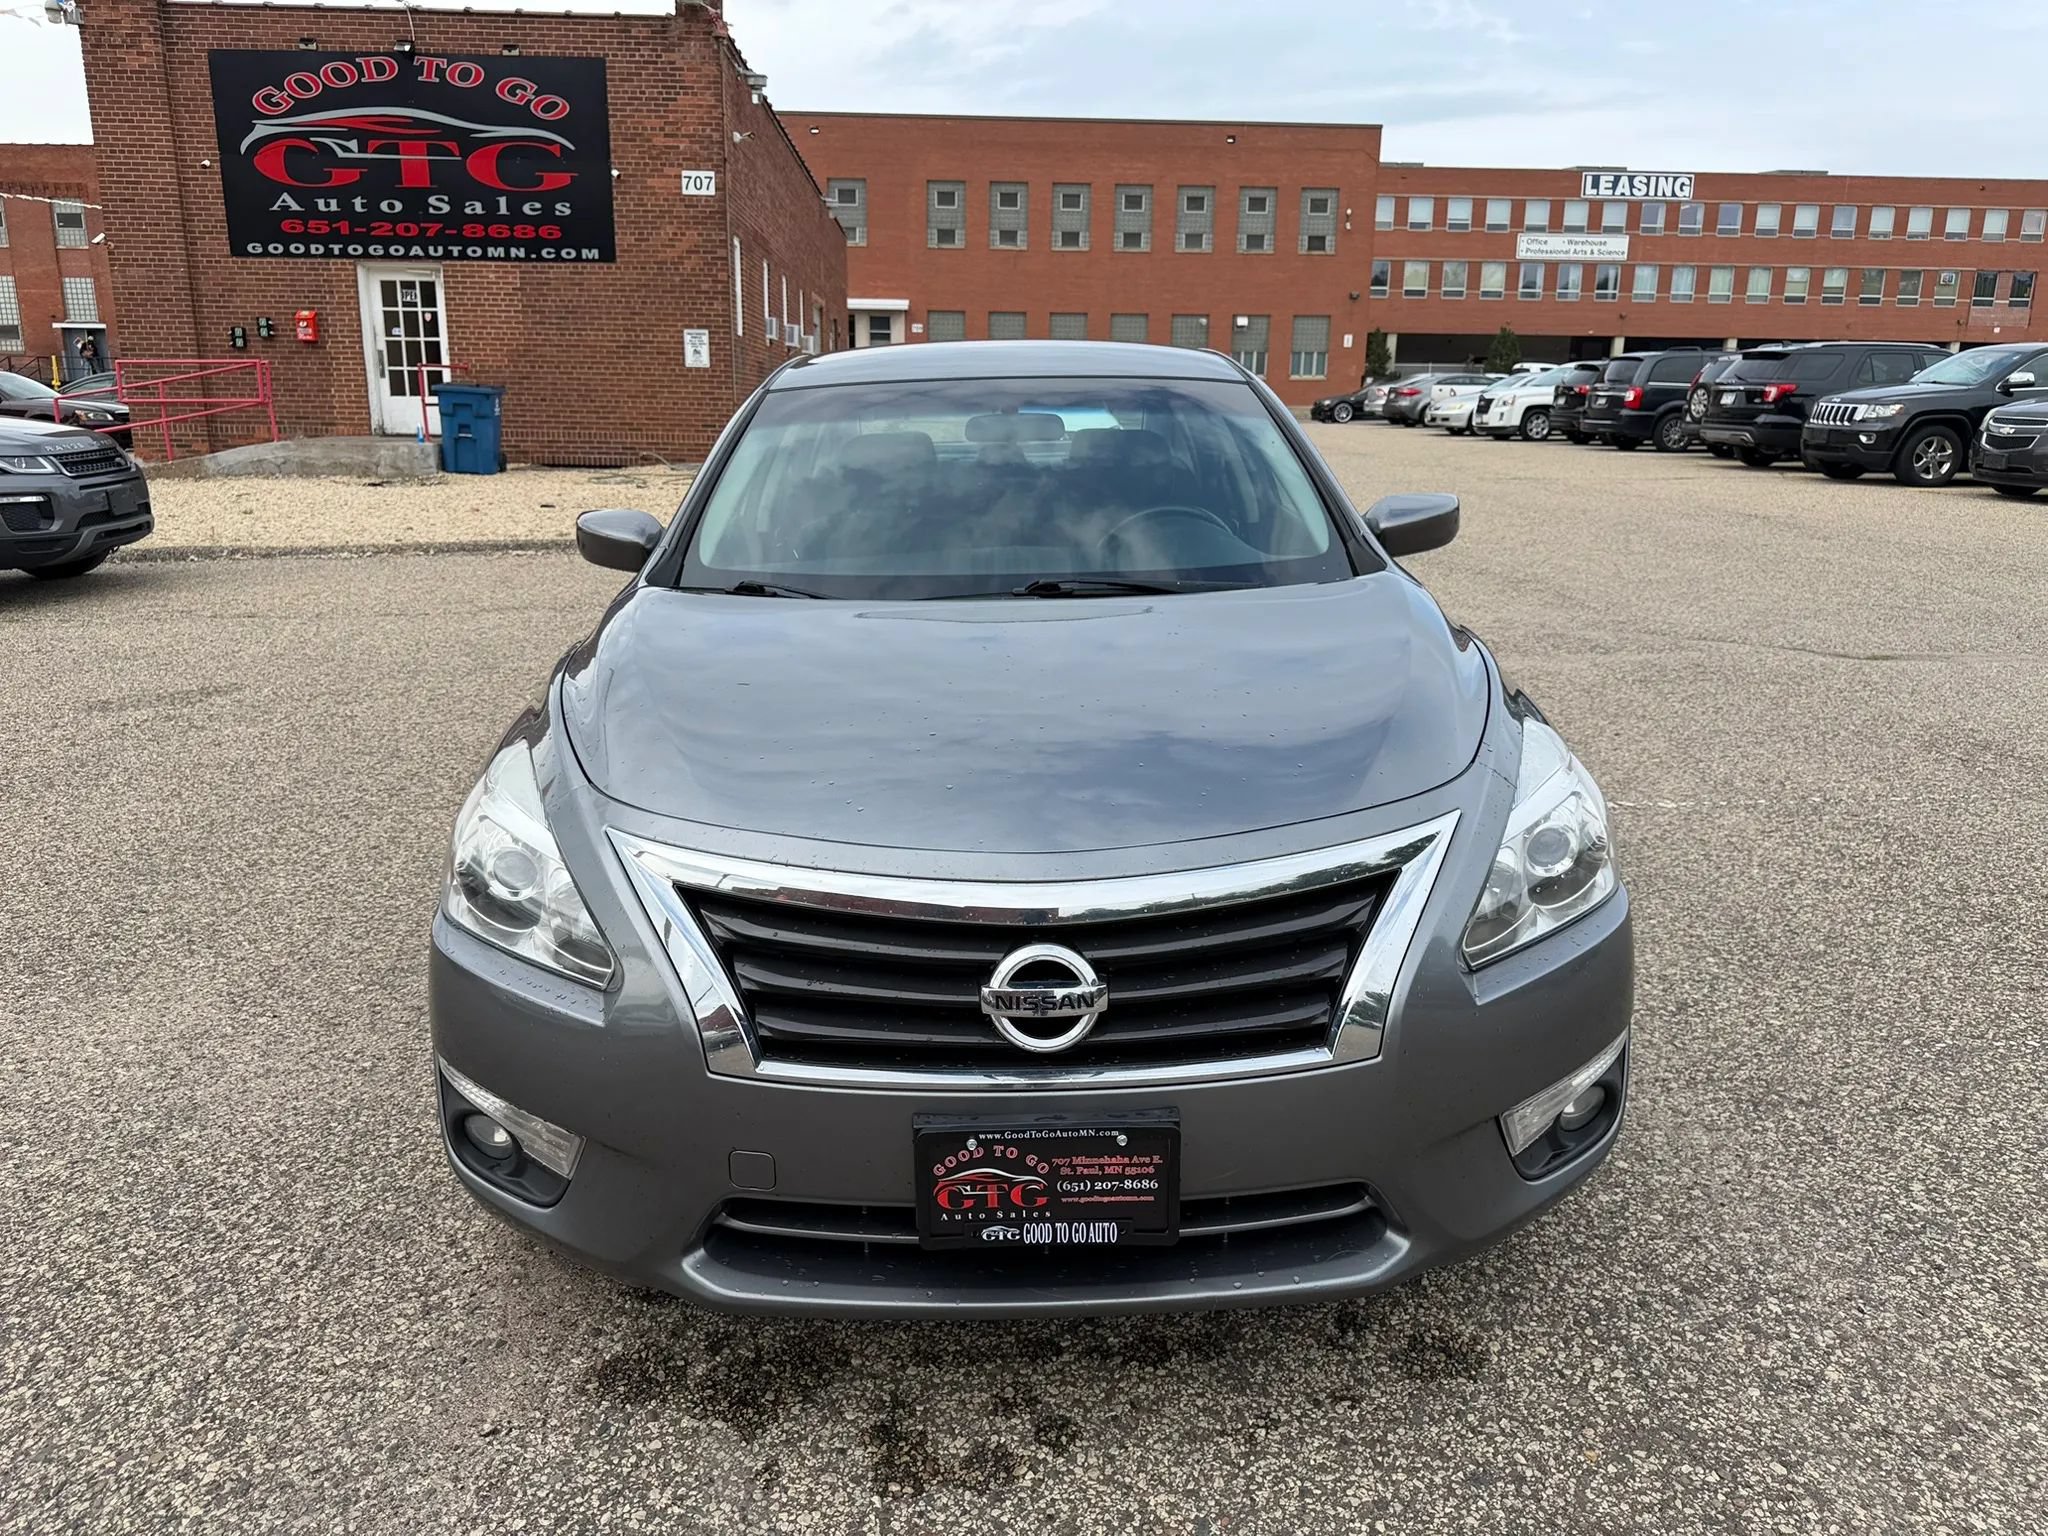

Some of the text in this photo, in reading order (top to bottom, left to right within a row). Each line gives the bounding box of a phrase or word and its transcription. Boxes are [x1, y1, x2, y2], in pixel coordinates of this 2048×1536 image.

[252, 55, 570, 120] GOOD TO GO
[253, 138, 579, 192] GTG
[683, 175, 714, 191] 707
[1585, 175, 1691, 197] LEASING
[269, 192, 572, 216] Auto Sales
[280, 218, 562, 239] 651-207-8686
[246, 242, 600, 260] GOODTOGOAUTOMN.COM
[1525, 247, 1571, 255] Professional
[1572, 248, 1588, 256] Arts
[1596, 248, 1625, 256] Science
[1526, 238, 1608, 247] Office Warehouse
[994, 992, 1095, 1011] NISSAN
[978, 1128, 1120, 1140] www.GoodToGoAutoMN.com
[933, 1145, 1050, 1176] GOOD TO GO
[1051, 1155, 1163, 1167] 707 Minnehaha Ave E.
[1060, 1165, 1155, 1175] St. Paul, MN 55106
[1057, 1179, 1158, 1192] (651) 207-8686
[937, 1183, 1050, 1210] GTG
[941, 1209, 1051, 1221] Auto Sales
[1023, 1222, 1053, 1244] GOOD
[1055, 1223, 1069, 1244] TO
[1071, 1223, 1087, 1243] GO
[1088, 1222, 1118, 1243] AUTO
